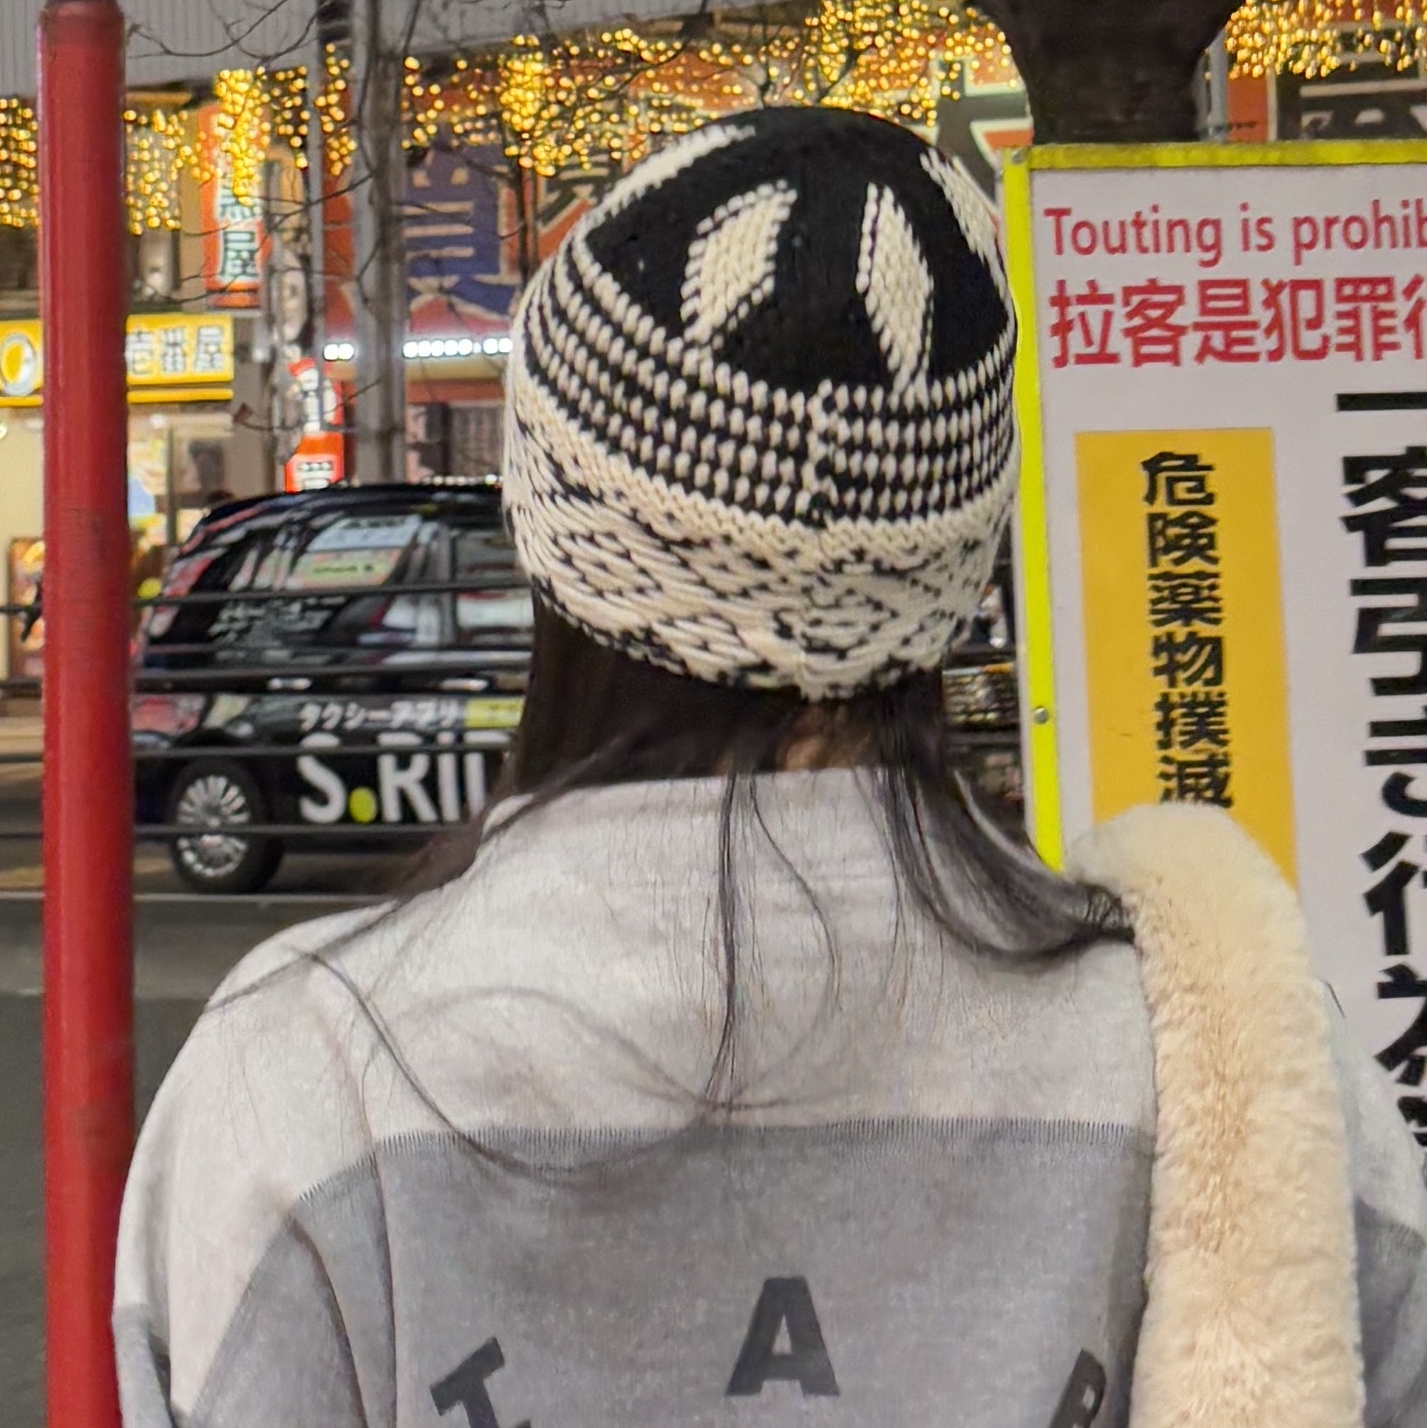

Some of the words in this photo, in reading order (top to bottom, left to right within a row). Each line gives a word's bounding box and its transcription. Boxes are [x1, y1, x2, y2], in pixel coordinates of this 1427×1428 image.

[1044, 204, 1222, 268] Touting
[1241, 202, 1275, 253] is
[1141, 450, 1234, 810] 危険薬物撲滅
